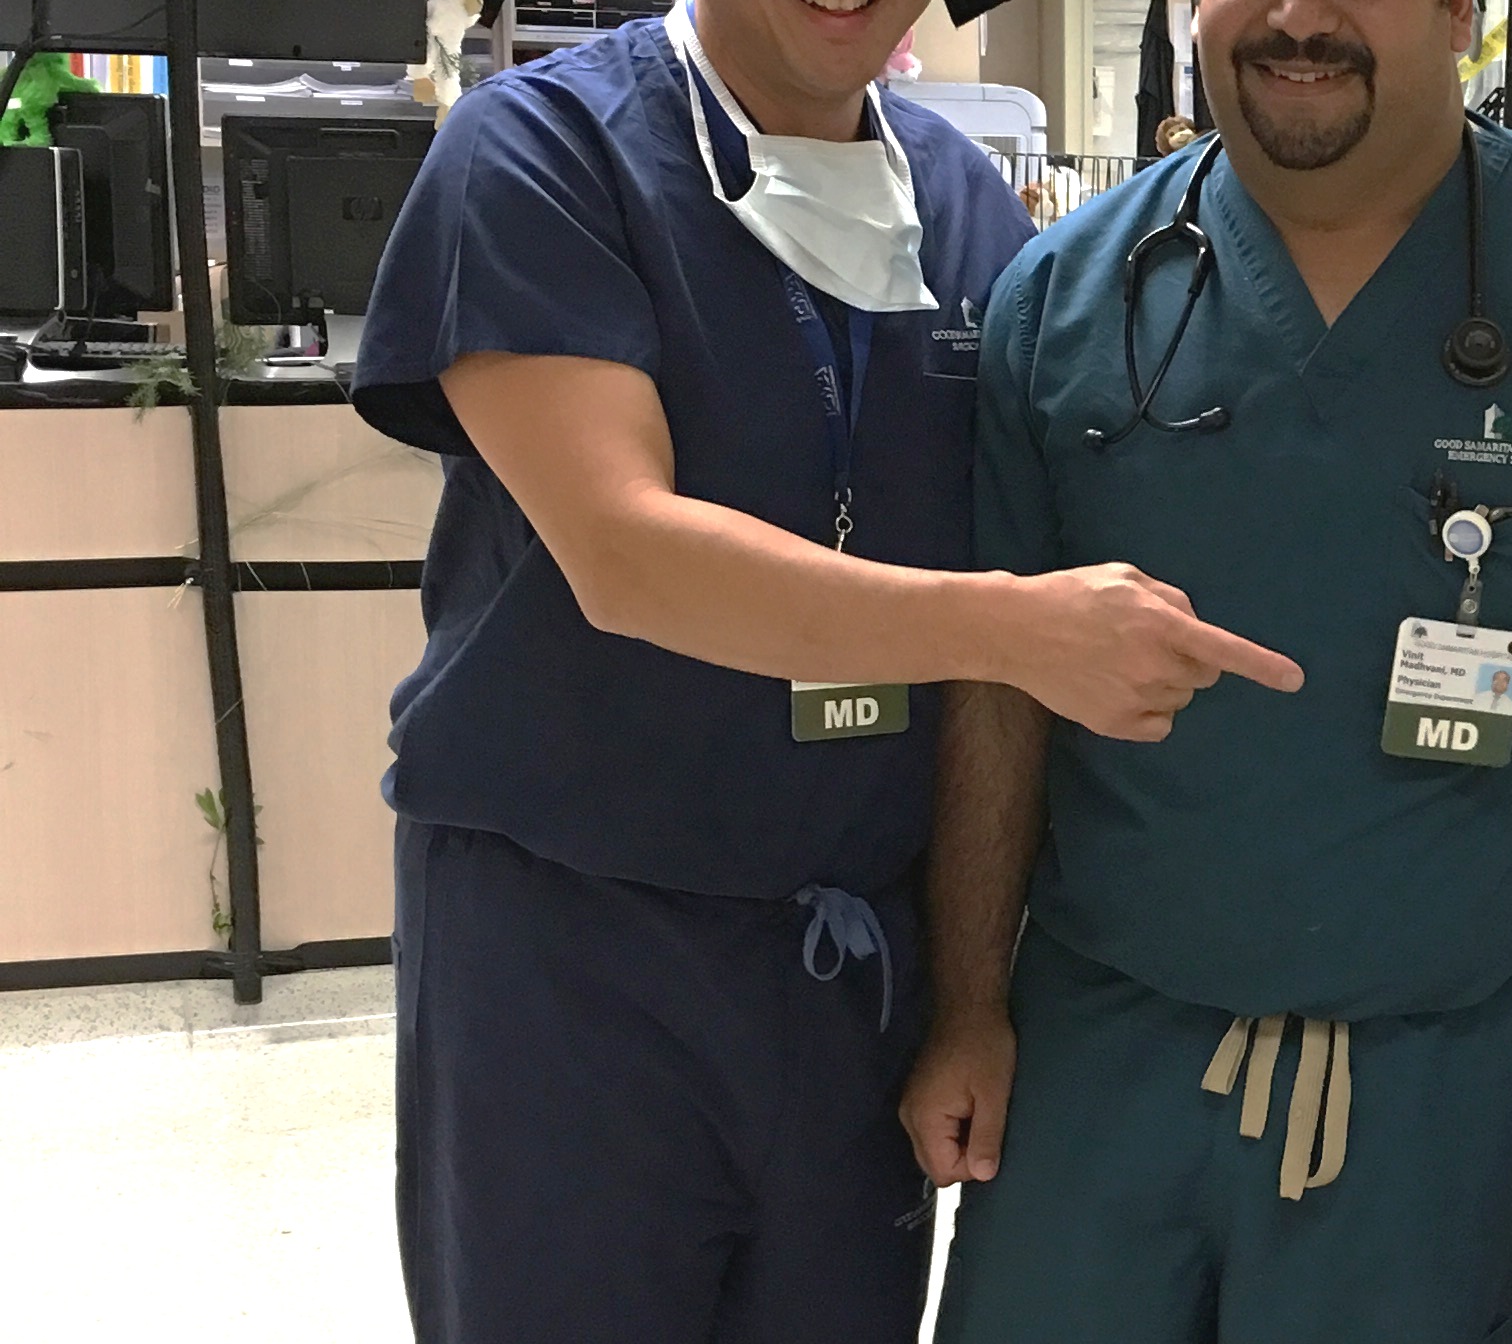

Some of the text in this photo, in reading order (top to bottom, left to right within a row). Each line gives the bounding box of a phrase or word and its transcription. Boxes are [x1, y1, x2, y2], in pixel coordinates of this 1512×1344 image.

[1434, 439, 1463, 449] GOOD
[1448, 450, 1509, 465] EMERGENCY
[1402, 650, 1424, 661] Vinit
[1450, 667, 1466, 677] MD
[1397, 675, 1441, 689] Physician
[824, 696, 880, 729] MD
[1416, 716, 1479, 751] MD
